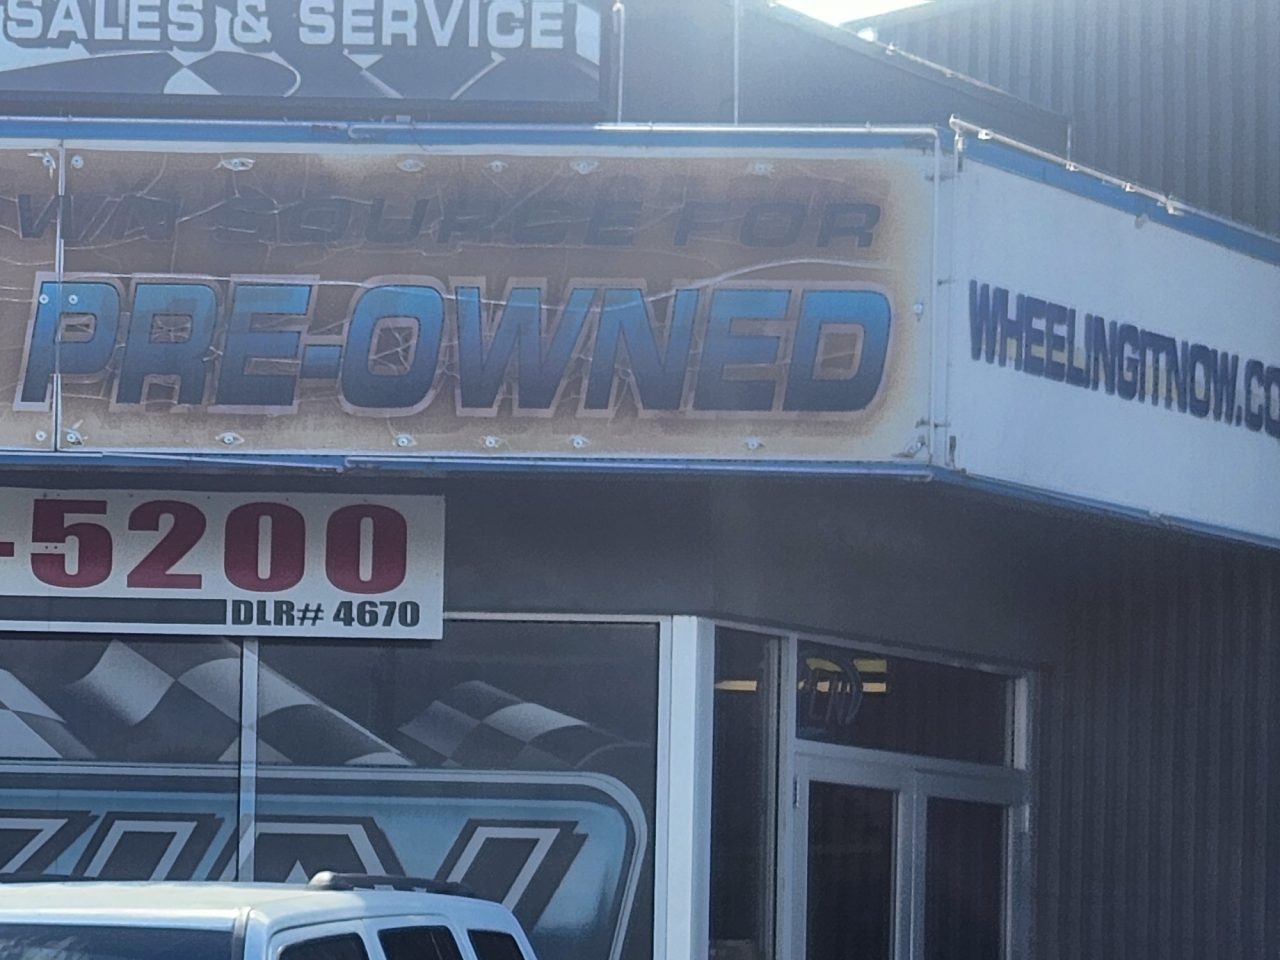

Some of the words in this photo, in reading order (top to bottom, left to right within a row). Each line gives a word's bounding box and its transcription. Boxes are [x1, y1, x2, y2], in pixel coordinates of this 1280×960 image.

[6, 0, 204, 43] SALES
[233, 0, 273, 43] &
[299, 0, 565, 49] SERVICE
[208, 197, 644, 248] SOURCE
[674, 200, 883, 249] FOR
[18, 274, 896, 415] PRE-OWNED
[231, 599, 325, 627] DLR#
[332, 600, 421, 628] 4670
